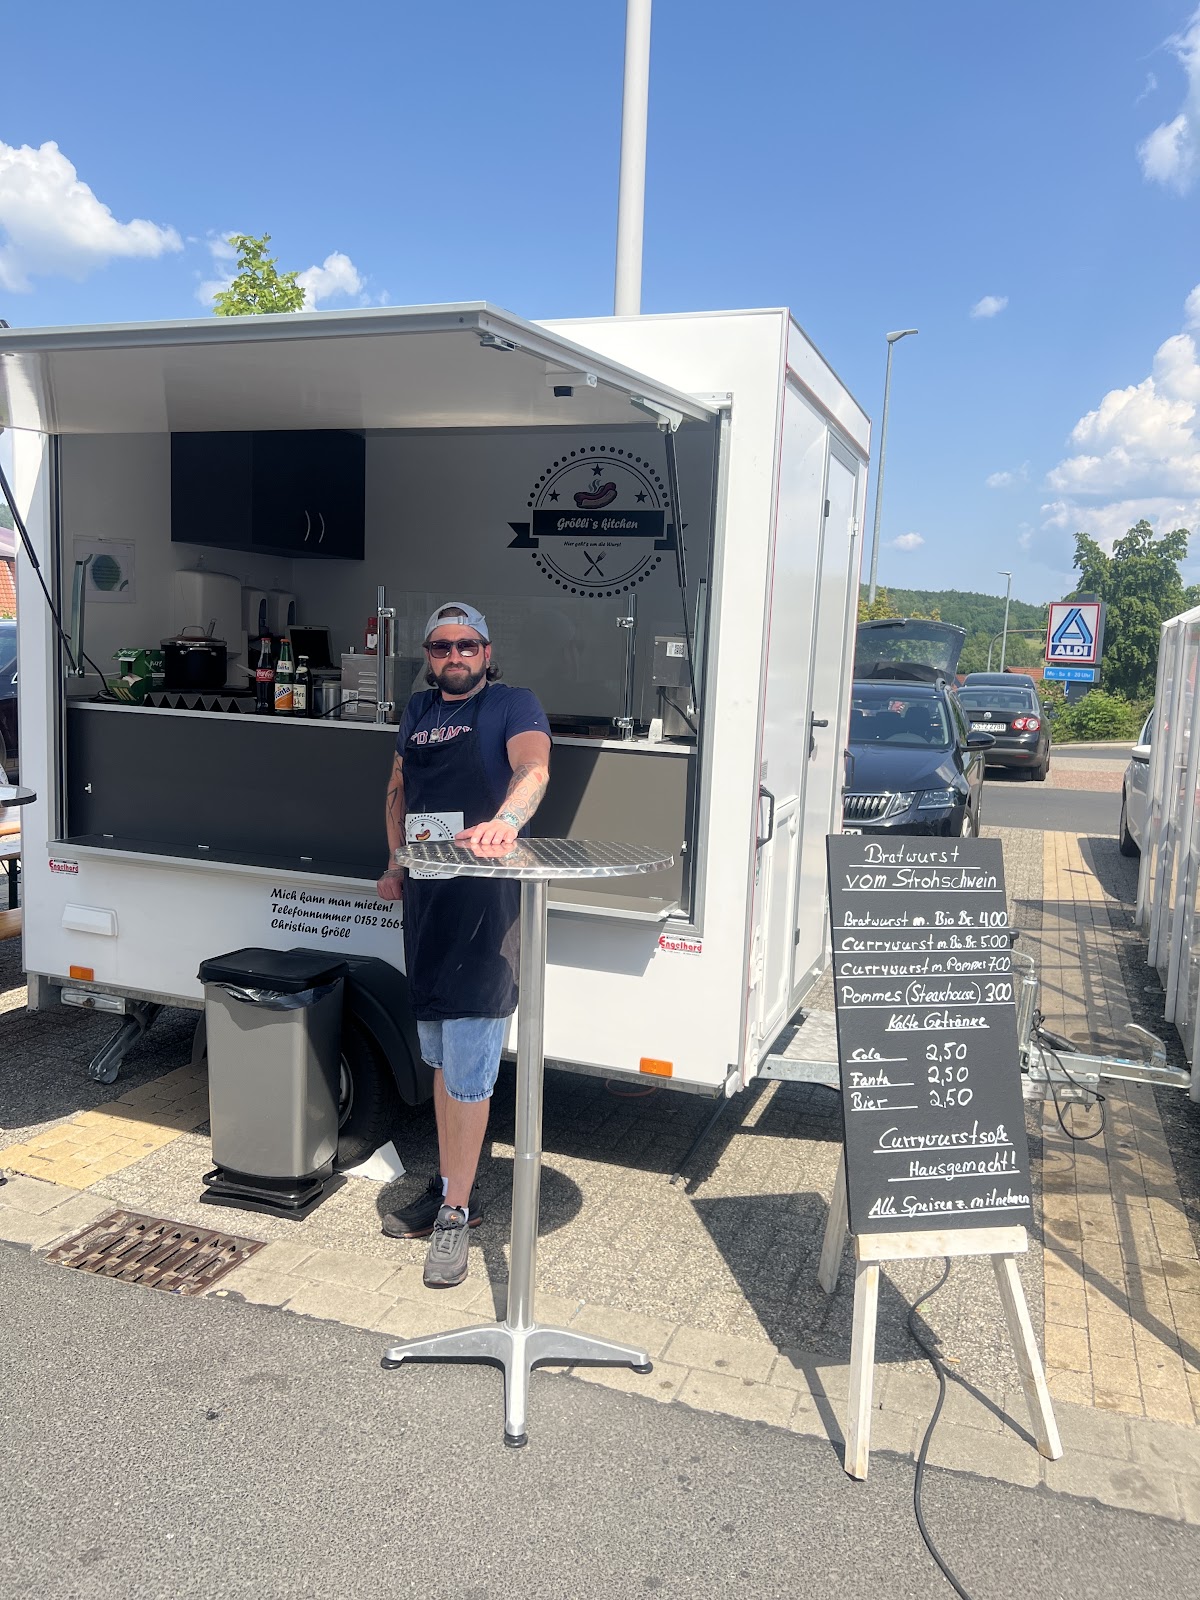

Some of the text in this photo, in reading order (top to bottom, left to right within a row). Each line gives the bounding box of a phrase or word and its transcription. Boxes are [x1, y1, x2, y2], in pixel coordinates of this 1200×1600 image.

[601, 518, 638, 530] kitchen
[1054, 646, 1088, 656] ALDI
[864, 844, 959, 864] Bratwurst
[892, 869, 997, 888] Strohschwein
[270, 888, 394, 912] Mich kann man mieten!
[271, 904, 352, 923] Telefonnummer
[354, 914, 378, 926] 0152
[844, 911, 908, 927] Bratwurst
[935, 911, 954, 926] Bio
[270, 918, 350, 938] Christian Gröll
[658, 936, 702, 952] Engelhard
[842, 934, 934, 951] Currywurst
[840, 957, 930, 976] Currywurst
[842, 985, 902, 1004] Pommes
[888, 1010, 988, 1030] Kalte Getränke
[852, 1042, 968, 1062] Cola 2,50
[850, 1066, 968, 1086] Fanta 2,50
[850, 1088, 973, 1109] Bier 2,50
[900, 1196, 952, 1218] Speisen
[970, 1188, 1030, 1208] mitnehmen
